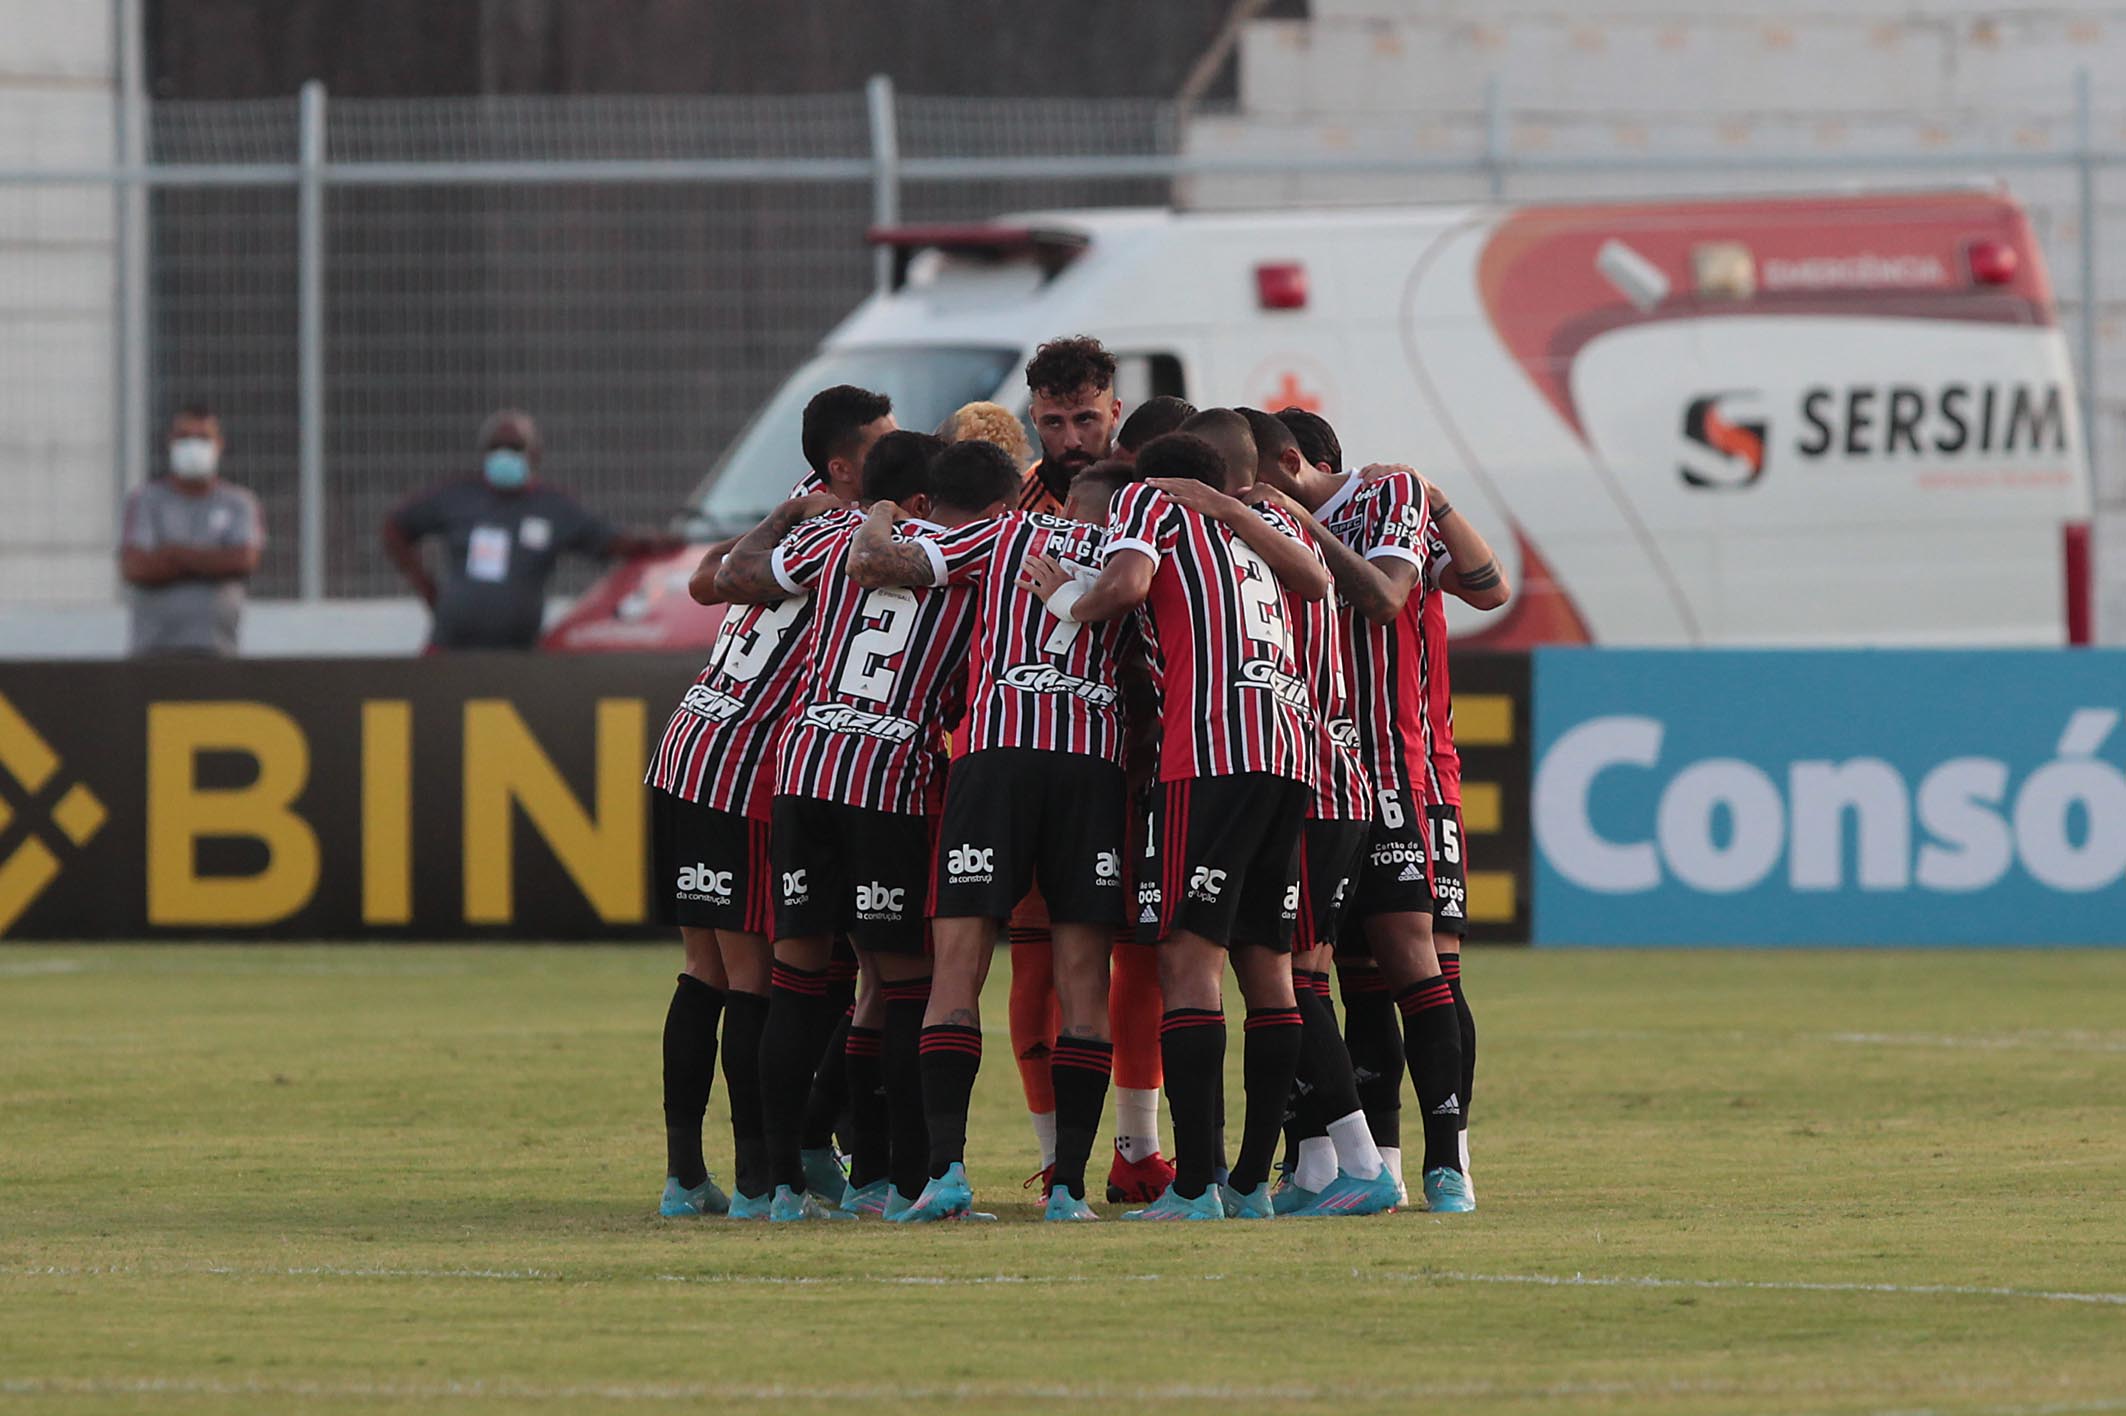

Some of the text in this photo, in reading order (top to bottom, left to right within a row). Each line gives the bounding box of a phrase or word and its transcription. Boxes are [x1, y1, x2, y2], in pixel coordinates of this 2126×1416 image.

[1798, 385, 2067, 457] SERSIM
[1048, 535, 1103, 564] RIGO
[840, 588, 919, 703] 2
[802, 703, 920, 741] GAZIN
[146, 698, 648, 925] BIN
[1377, 789, 1405, 830] 6
[1530, 707, 2126, 894] Consó
[947, 843, 993, 874] abc
[1370, 849, 1425, 866] TODOS
[1375, 841, 1418, 851] Cartão de
[1429, 818, 1461, 864] 15
[676, 862, 733, 896] abc
[856, 881, 905, 911] abc
[676, 891, 731, 906] da construção
